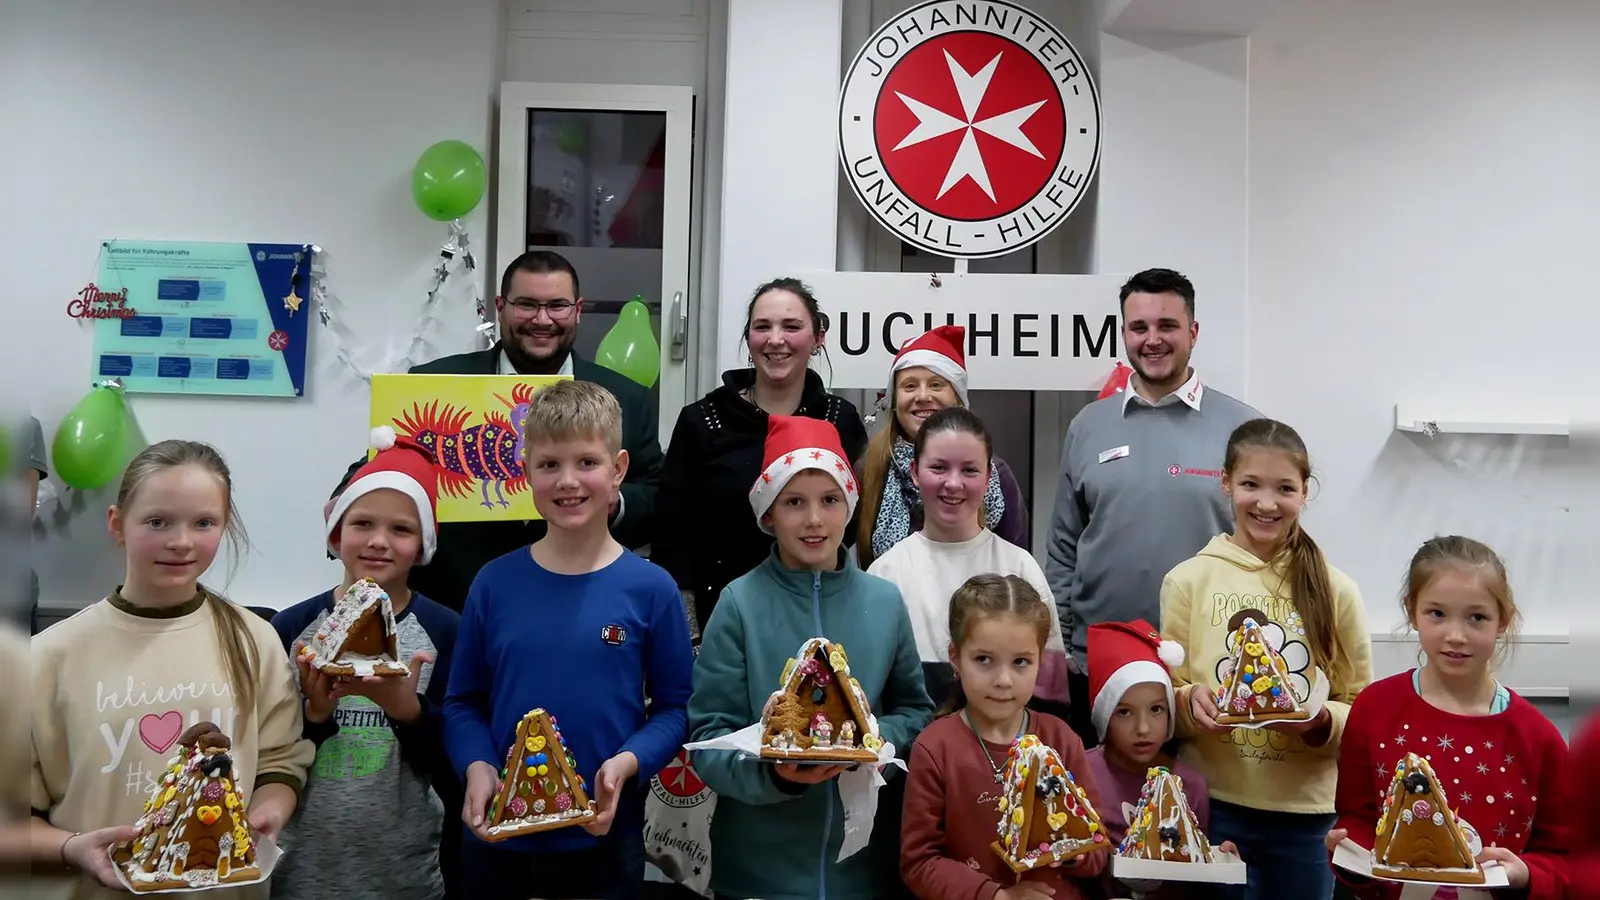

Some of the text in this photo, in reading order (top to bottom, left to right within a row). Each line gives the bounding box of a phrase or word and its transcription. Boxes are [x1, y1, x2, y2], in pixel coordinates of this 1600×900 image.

[67, 299, 136, 319] Christmas
[78, 284, 128, 309] Merry
[817, 311, 1118, 358] UCHEIM
[97, 676, 207, 712] believe
